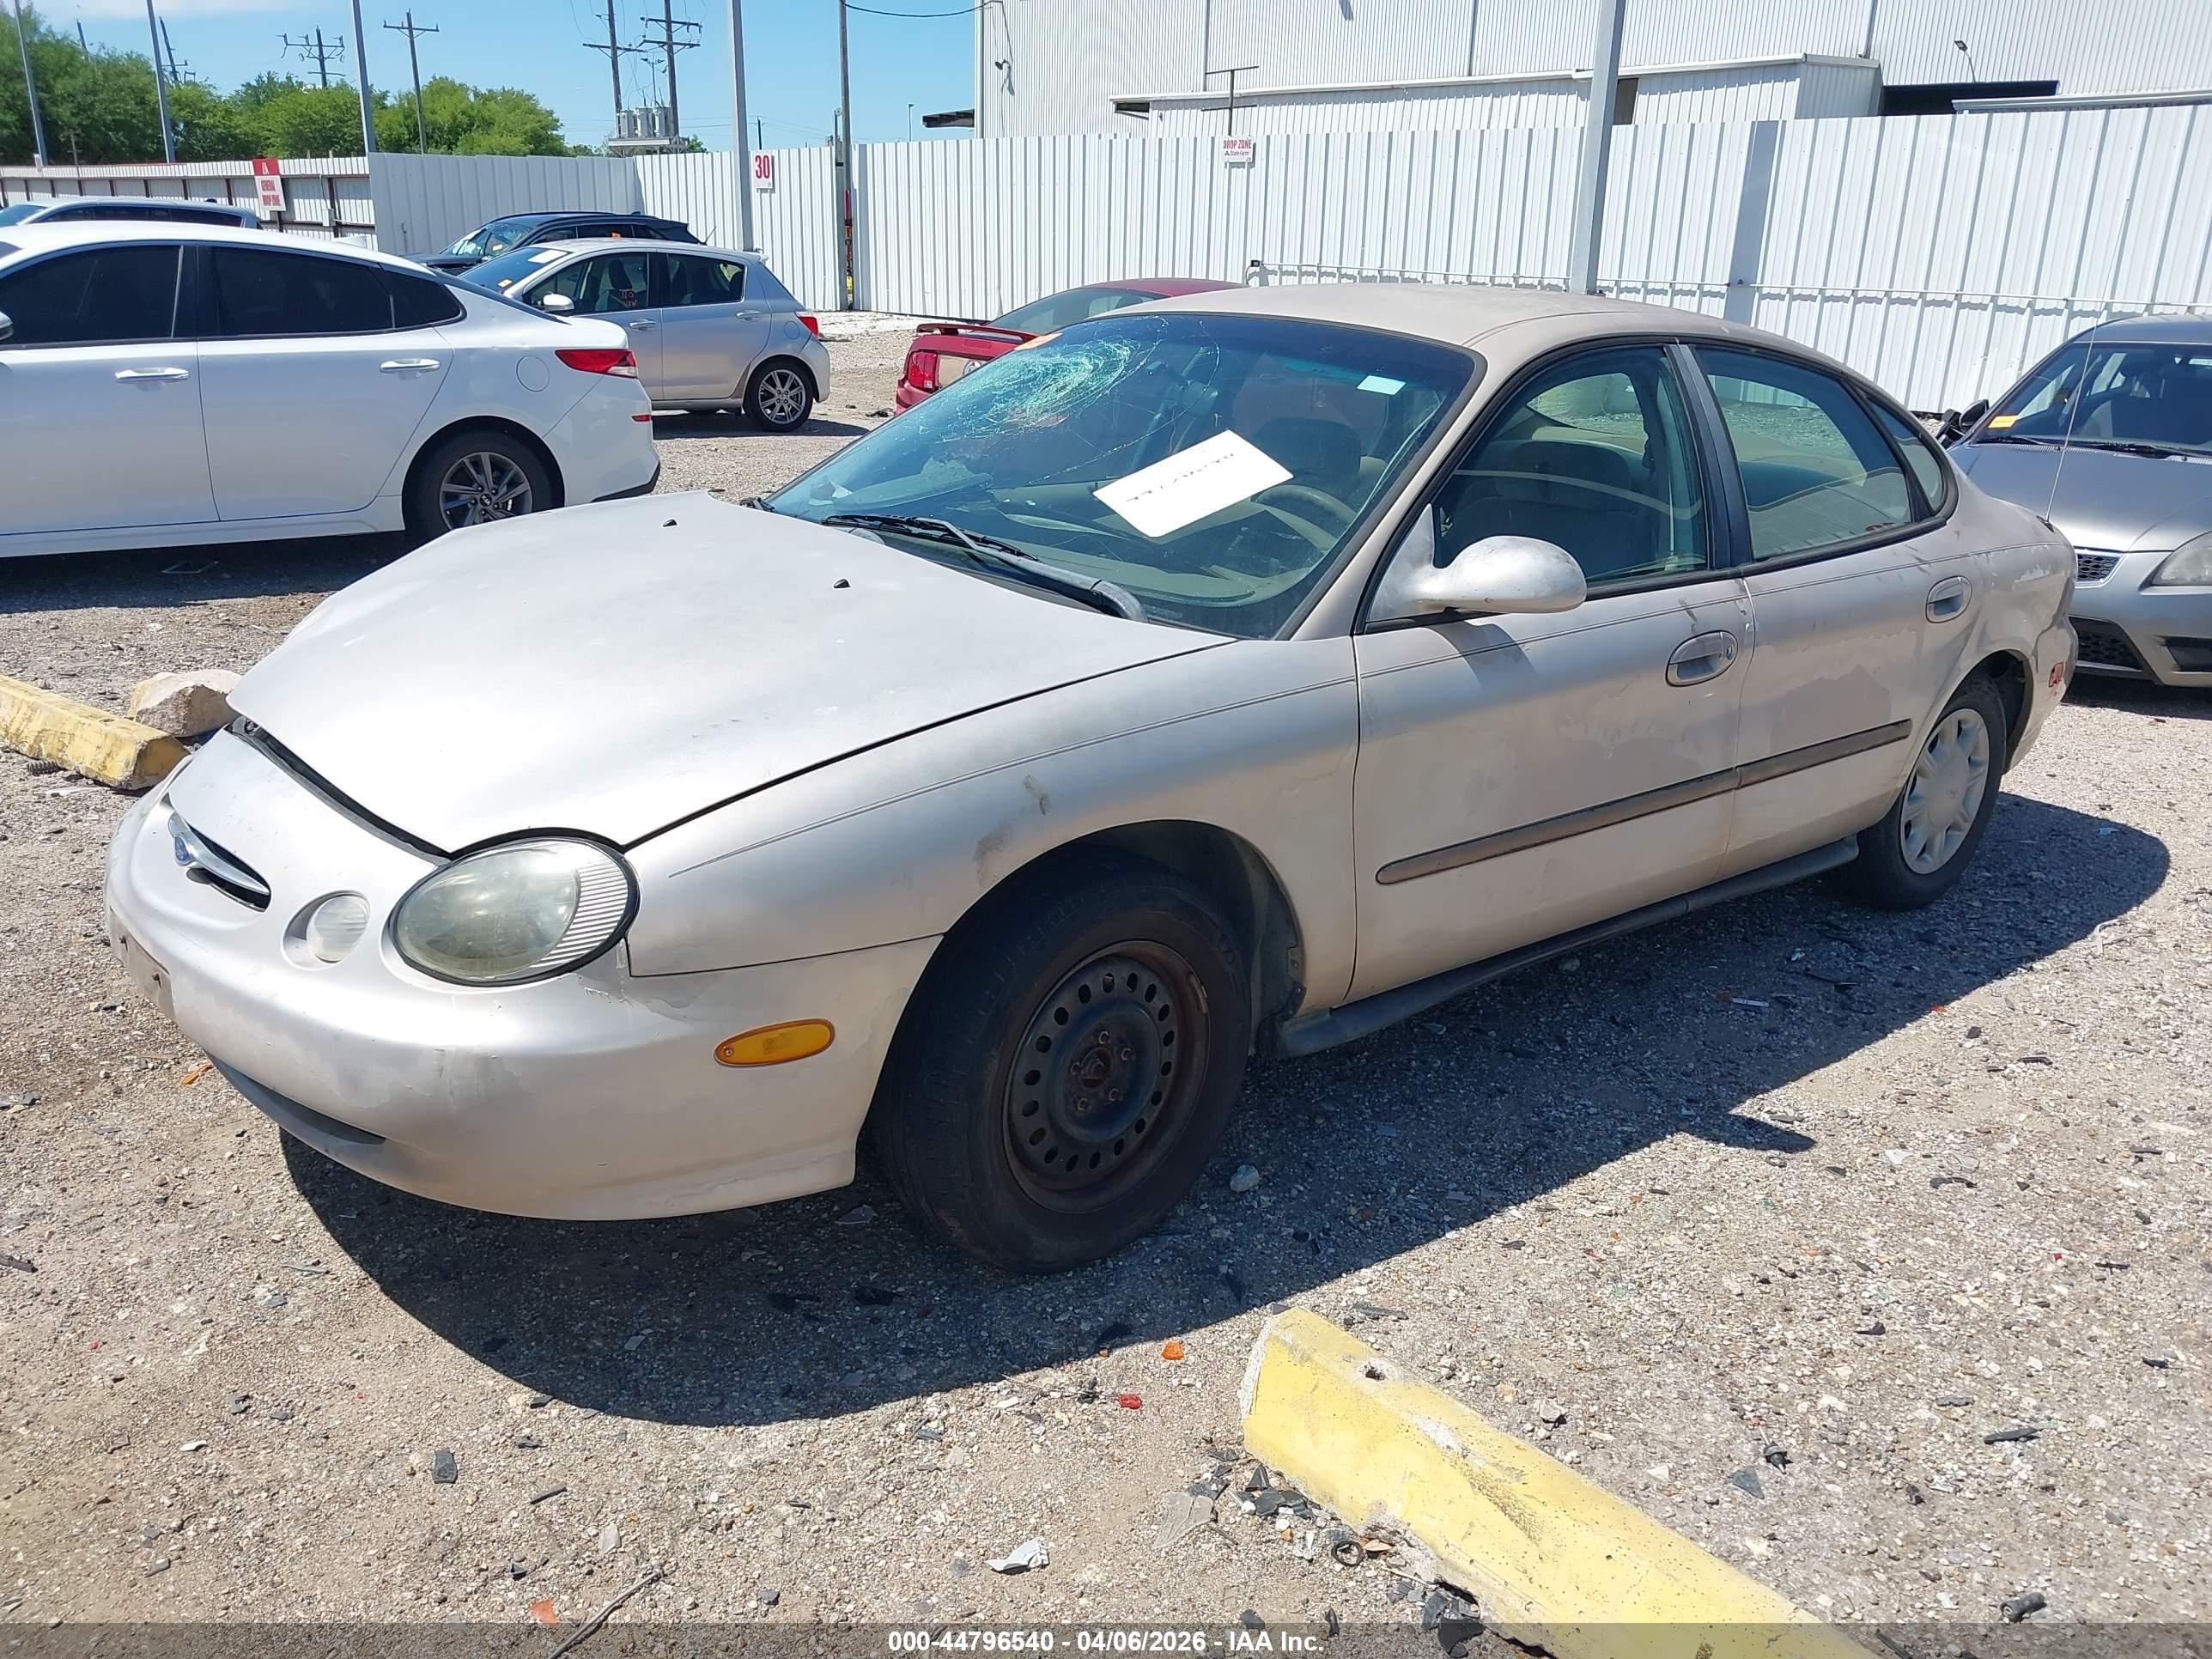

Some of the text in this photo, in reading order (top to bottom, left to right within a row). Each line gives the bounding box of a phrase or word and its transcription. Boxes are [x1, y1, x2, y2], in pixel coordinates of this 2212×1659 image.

[1224, 140, 1251, 149] DROP ZONE
[755, 155, 770, 179] 30
